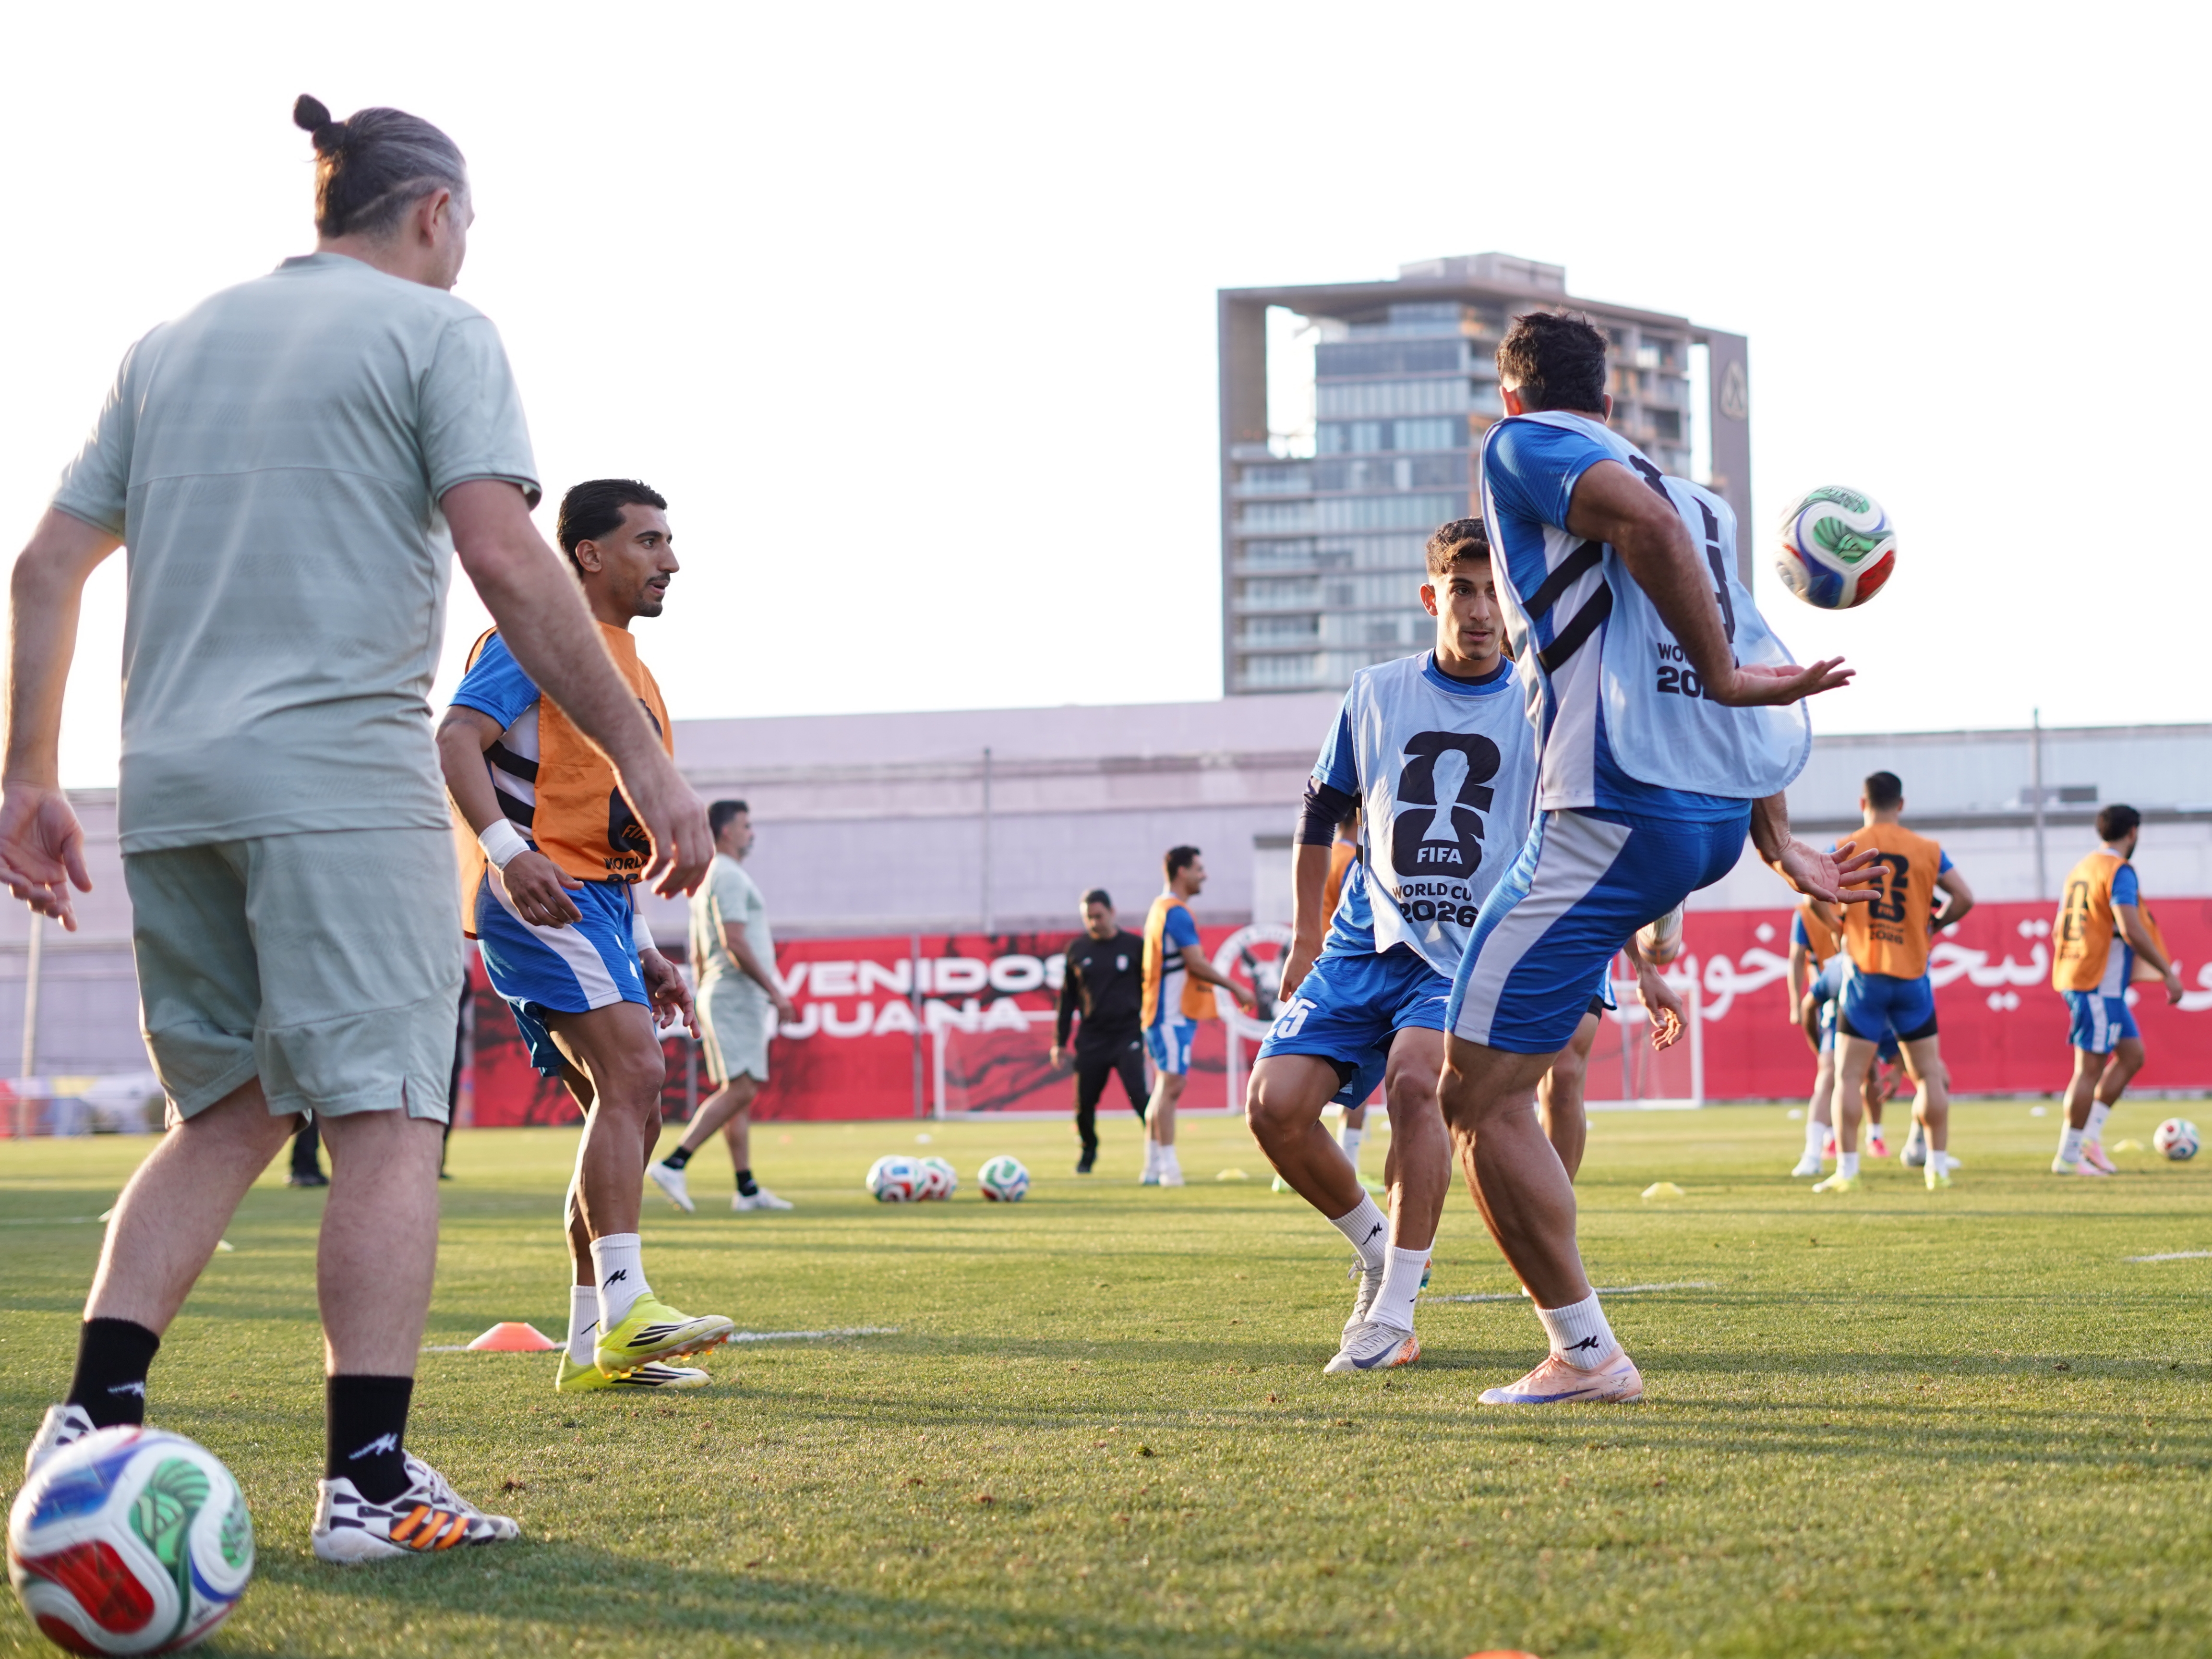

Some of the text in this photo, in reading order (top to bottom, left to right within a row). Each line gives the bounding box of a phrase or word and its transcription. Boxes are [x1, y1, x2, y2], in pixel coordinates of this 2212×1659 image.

[1657, 666, 1713, 700] 20
[1417, 847, 1463, 865] FIFA
[1393, 882, 1473, 902] WORLD CU
[1399, 899, 1479, 928] 2026
[767, 996, 1030, 1040] IJUANA
